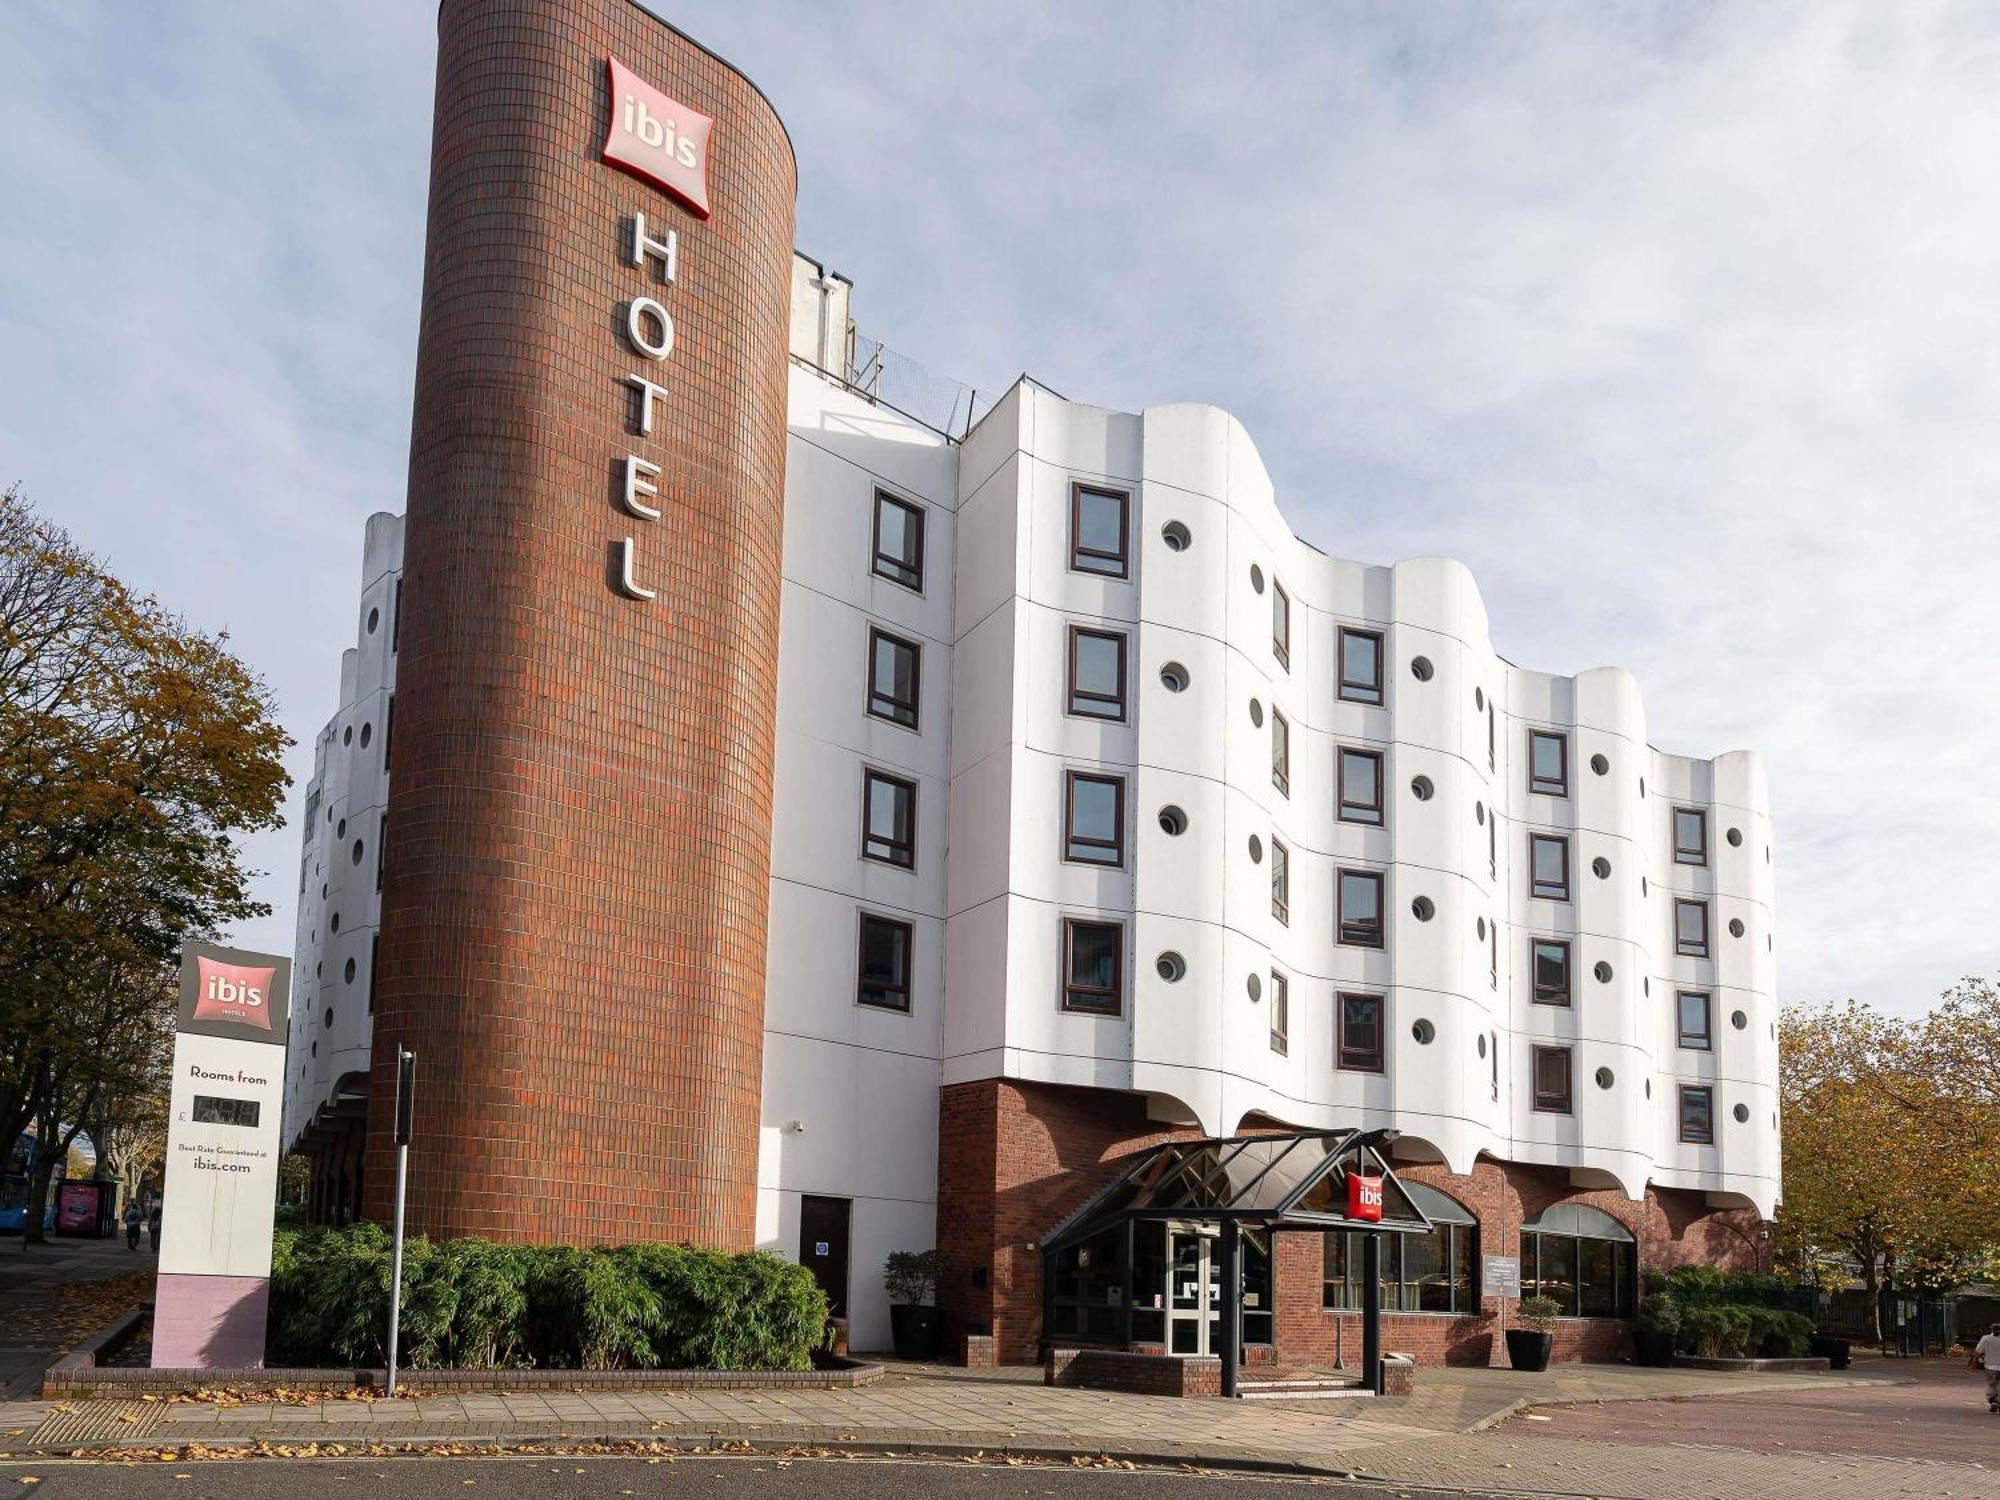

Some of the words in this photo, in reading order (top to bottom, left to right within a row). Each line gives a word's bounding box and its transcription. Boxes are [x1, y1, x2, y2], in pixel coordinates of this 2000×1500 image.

[624, 94, 697, 168] ibis
[623, 211, 677, 600] HOTEL
[208, 975, 262, 1007] ibis
[190, 1065, 235, 1082] Rooms
[237, 1070, 268, 1086] from
[216, 1146, 259, 1157] Guaranteed
[193, 1156, 251, 1173] ibis.com
[1360, 1186, 1382, 1206] ibis
